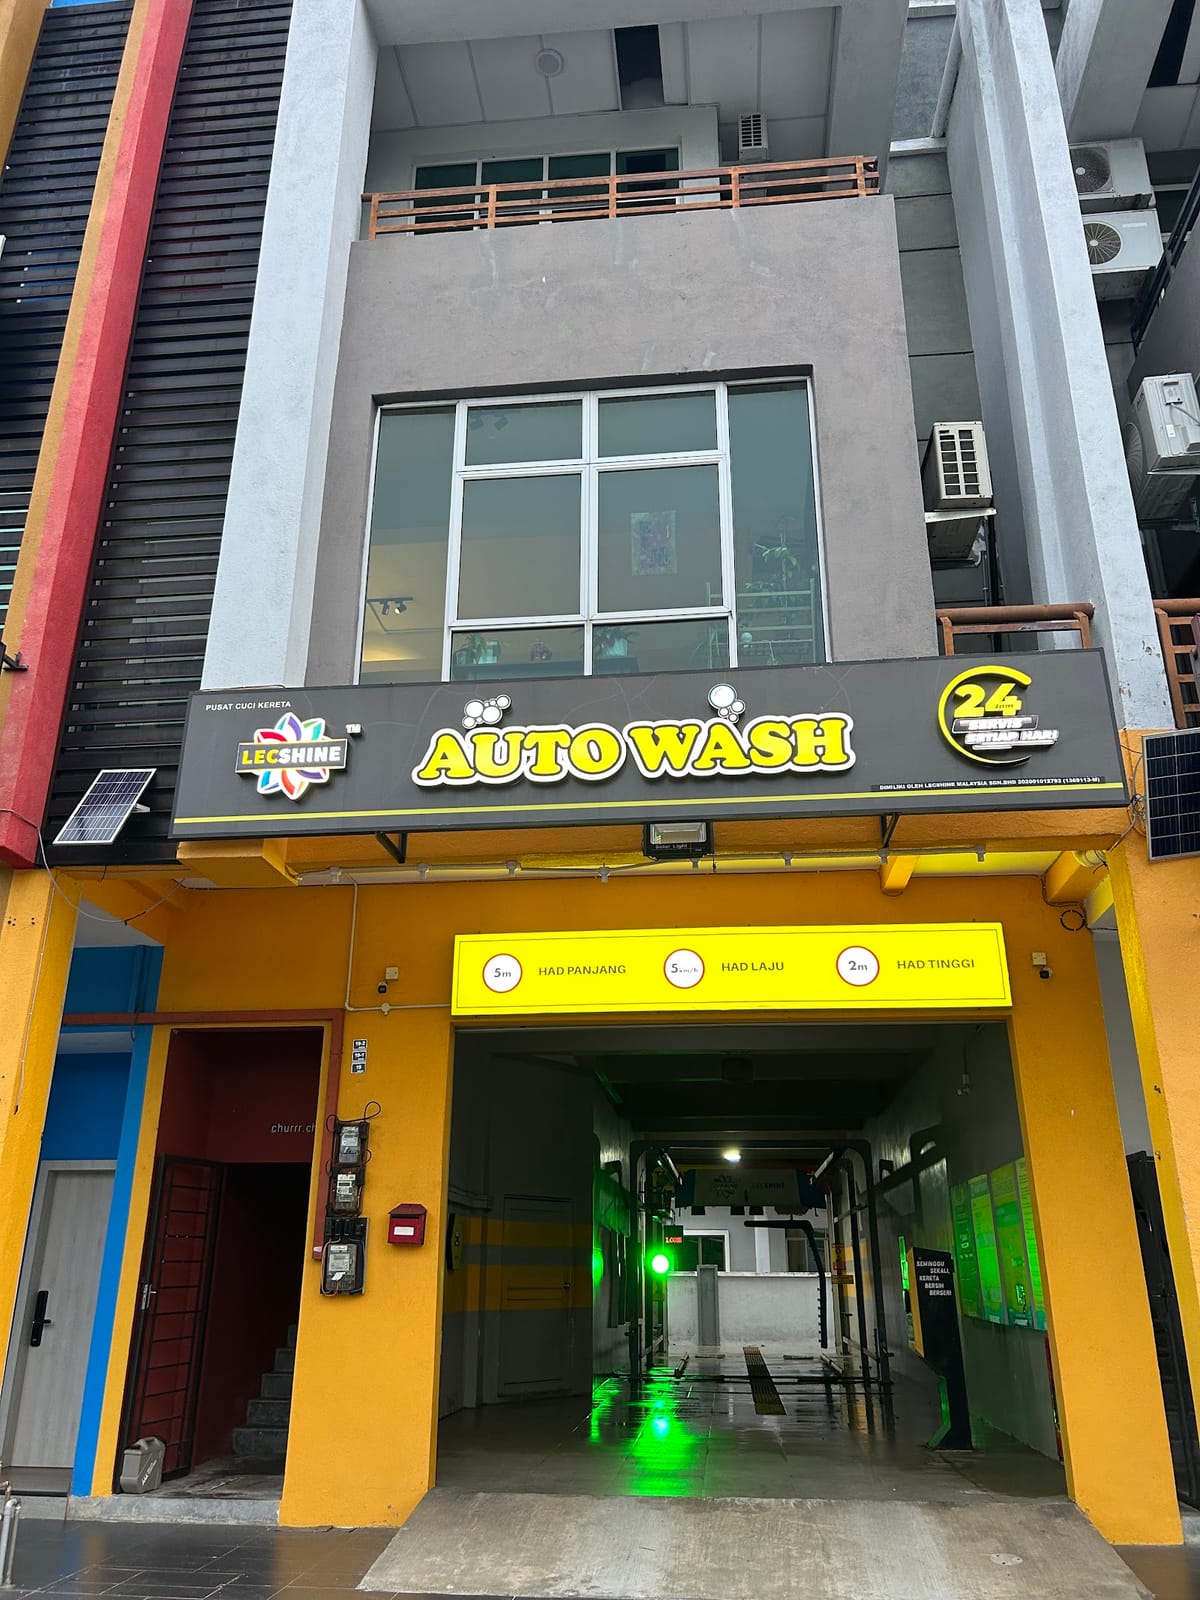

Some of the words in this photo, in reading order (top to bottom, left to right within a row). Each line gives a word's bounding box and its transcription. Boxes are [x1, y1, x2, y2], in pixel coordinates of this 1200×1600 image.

[205, 703, 233, 711] PUSAT
[235, 702, 256, 710] CUCI
[257, 701, 292, 709] KERETA
[953, 683, 1022, 718] 24
[416, 727, 623, 780] AUTO
[628, 716, 850, 773] WASH
[241, 746, 341, 764] LECSHINE
[906, 782, 924, 790] OLEH
[956, 780, 988, 788] MALAYSIA
[538, 966, 565, 976] HAD
[566, 964, 627, 975] PANJANG
[721, 961, 749, 972] HAD
[750, 960, 785, 972] LAJU
[847, 960, 868, 971] 2m
[896, 959, 926, 970] HAD
[928, 958, 976, 970] TINGGI
[493, 967, 512, 979] 5m
